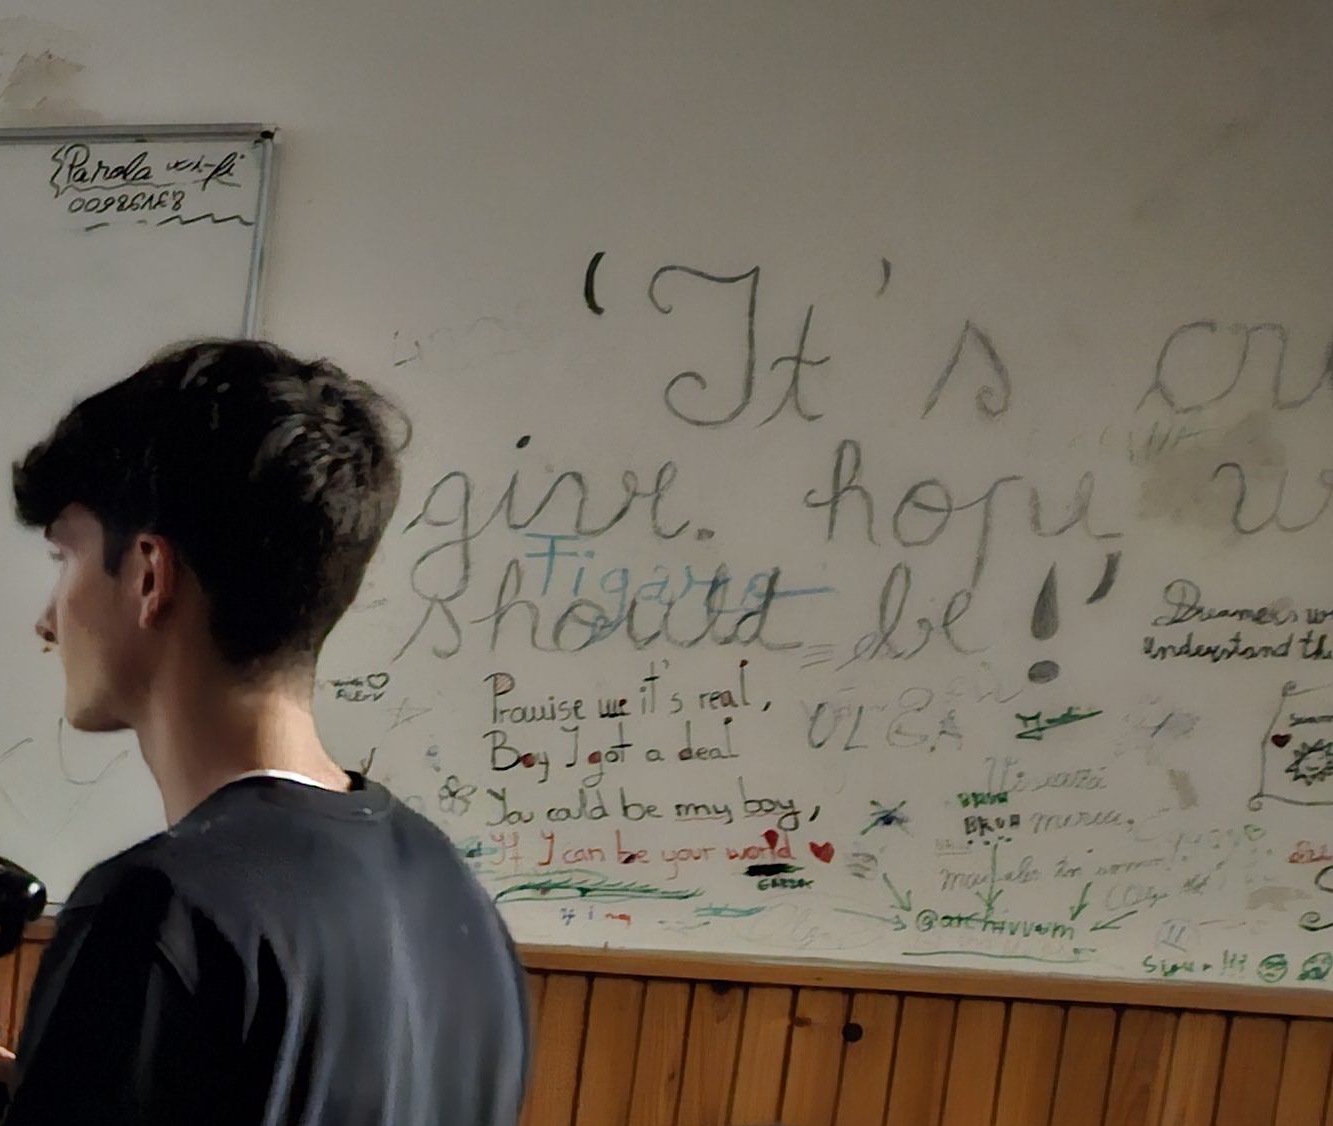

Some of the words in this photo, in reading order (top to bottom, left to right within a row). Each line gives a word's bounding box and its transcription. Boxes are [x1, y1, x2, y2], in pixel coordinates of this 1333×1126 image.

[64, 143, 153, 185] Parola
[391, 557, 805, 662] should
[481, 729, 551, 784] Boy
[619, 786, 664, 822] be
[674, 801, 735, 826] my
